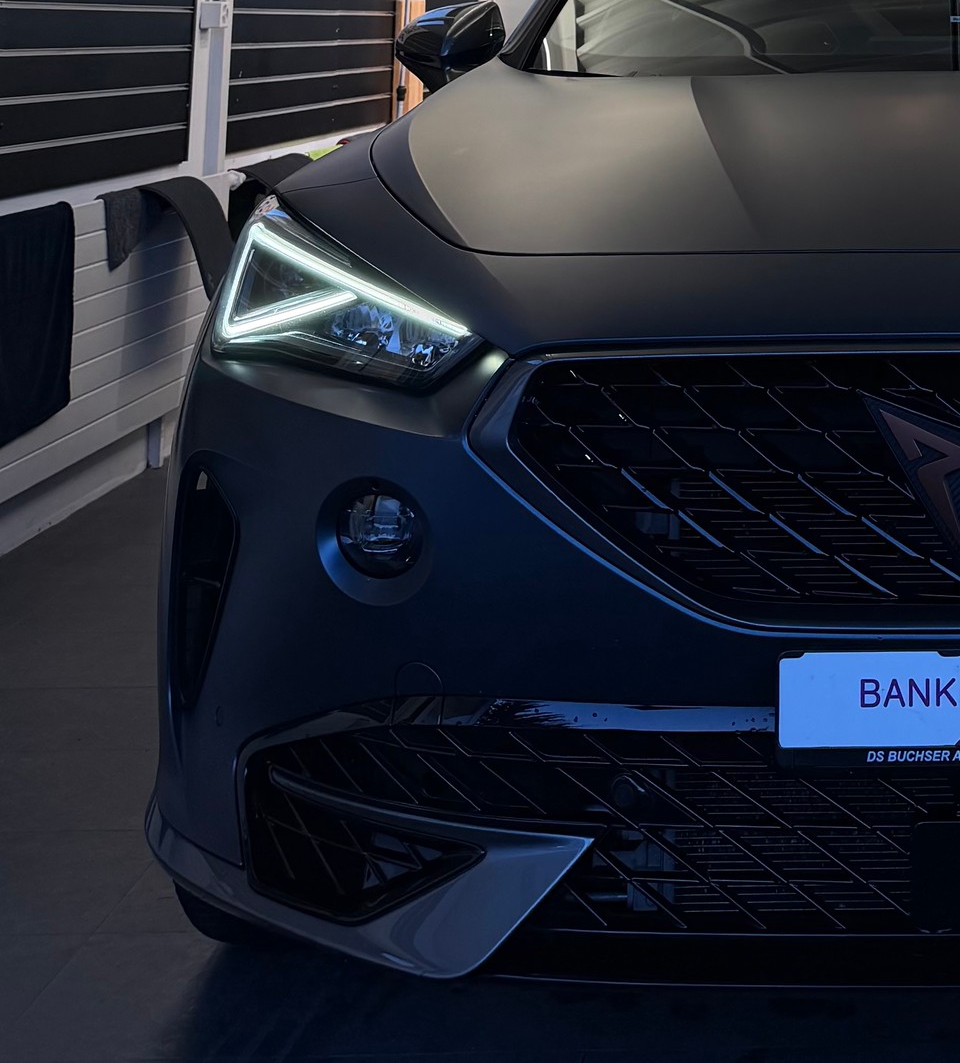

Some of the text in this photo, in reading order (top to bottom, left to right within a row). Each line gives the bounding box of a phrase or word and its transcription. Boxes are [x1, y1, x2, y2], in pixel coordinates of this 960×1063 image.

[860, 678, 957, 708] BANK
[867, 750, 885, 763] DS
[888, 750, 950, 762] BUCHSER
